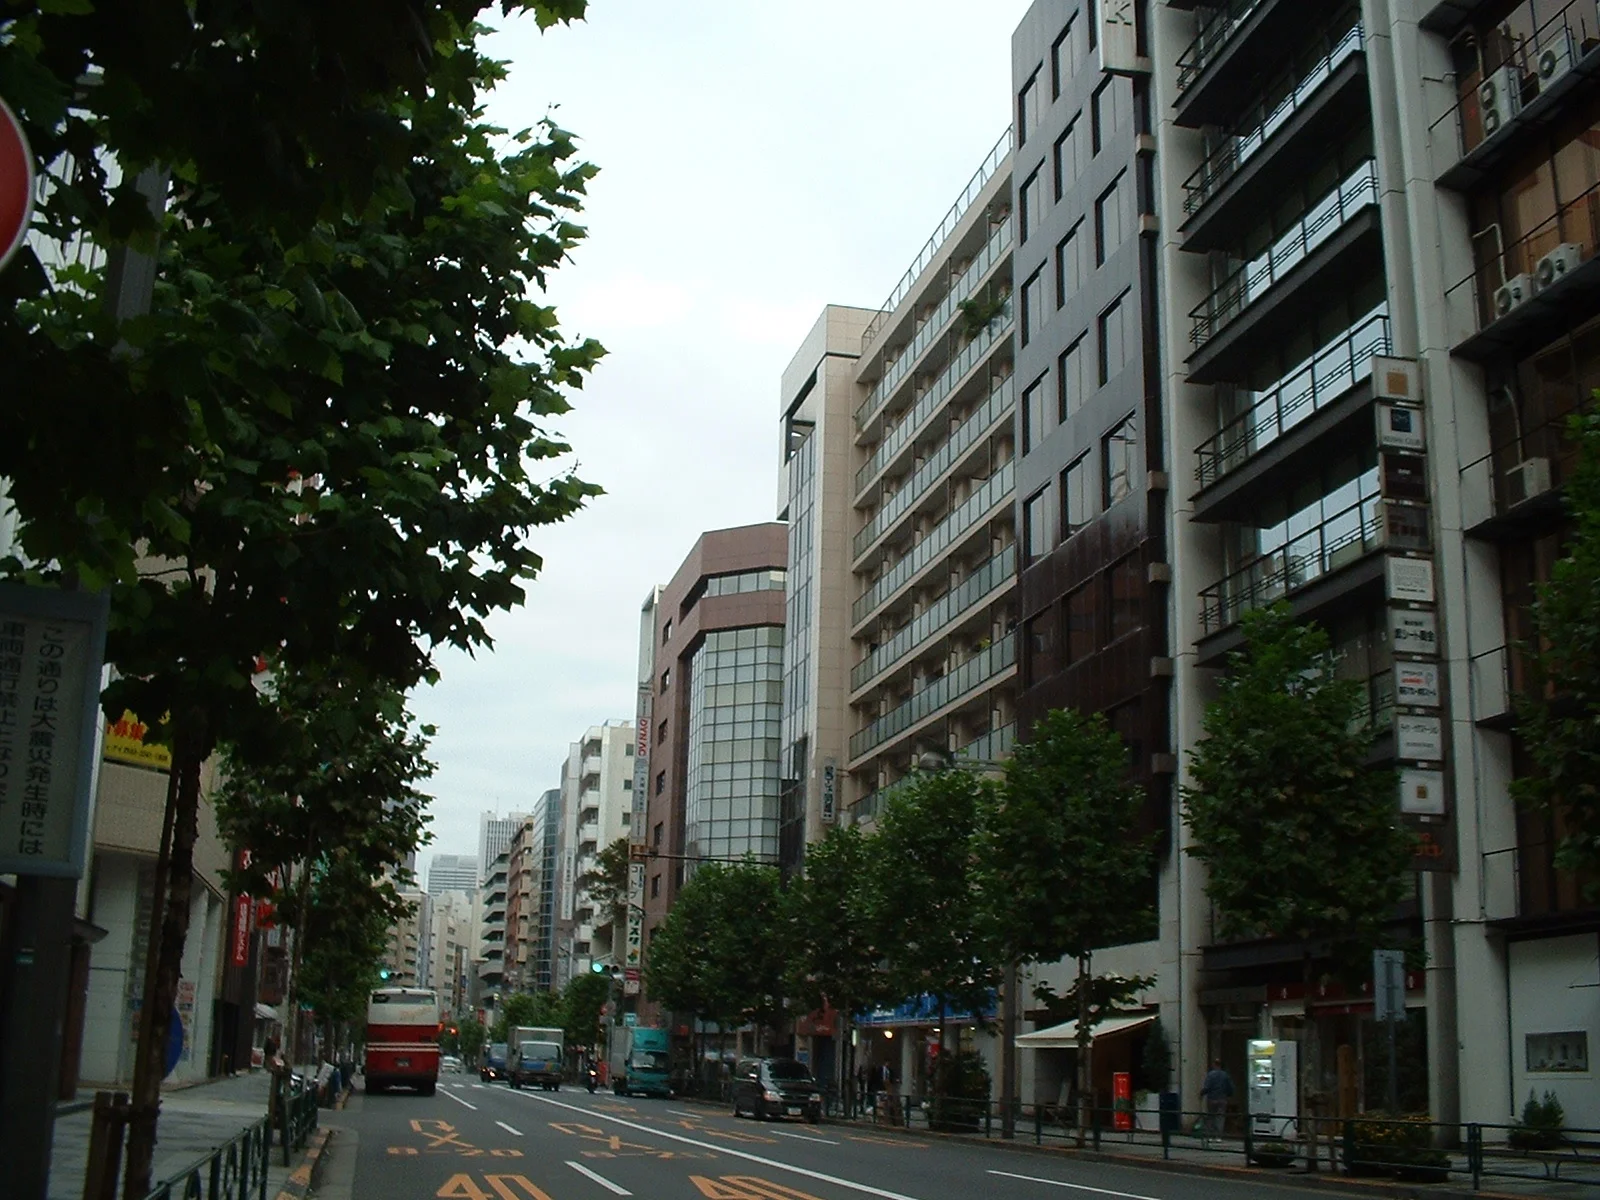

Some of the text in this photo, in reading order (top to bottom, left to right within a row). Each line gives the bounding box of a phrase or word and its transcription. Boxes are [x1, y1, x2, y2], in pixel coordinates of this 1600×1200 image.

[18, 623, 64, 856] この通りは大震災発生時には
